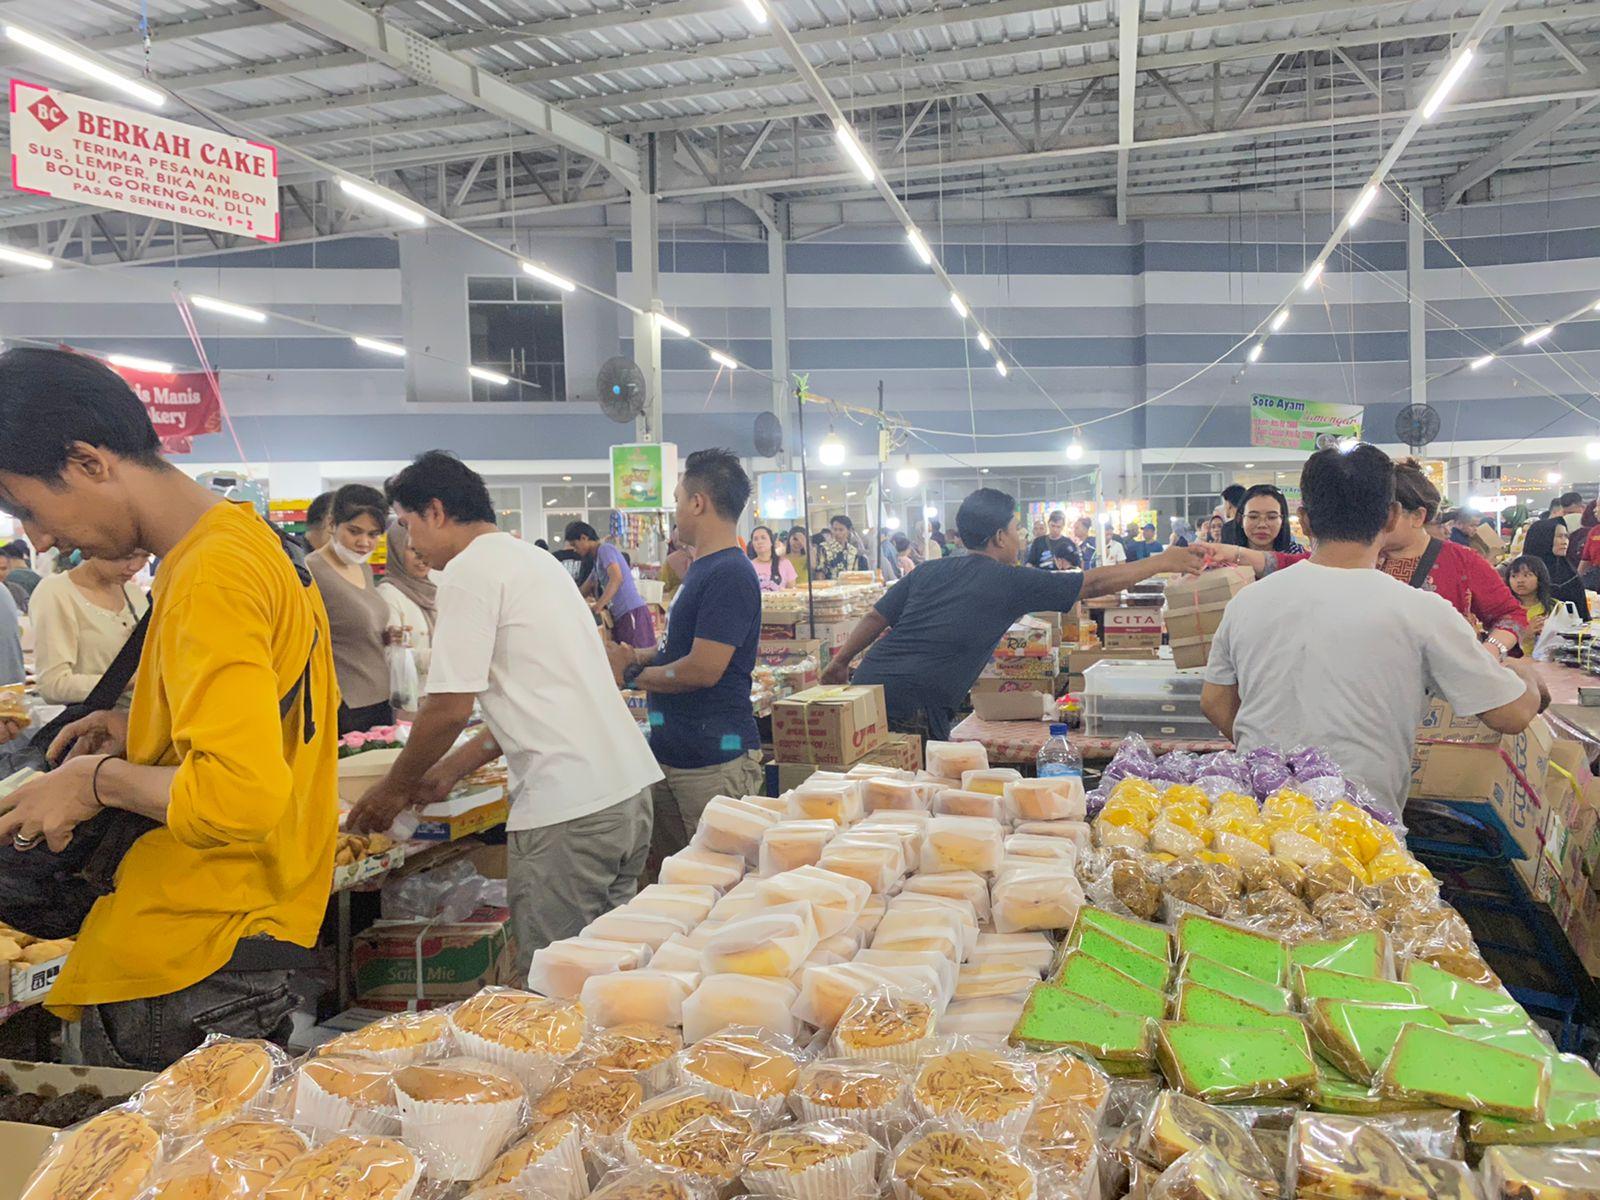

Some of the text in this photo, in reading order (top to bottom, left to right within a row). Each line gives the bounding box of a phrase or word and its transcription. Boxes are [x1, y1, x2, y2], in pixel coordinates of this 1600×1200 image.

[37, 103, 60, 123] BC
[78, 111, 265, 177] BERKAH CAKE
[73, 139, 230, 185] TERIMA PESANAN
[73, 183, 123, 200] PASAR
[129, 194, 175, 211] SENEN
[156, 173, 196, 190] BIKA
[204, 184, 266, 206] AMBON
[225, 201, 252, 216] DLL
[131, 383, 201, 405] is Manis
[1252, 395, 1304, 411] Soto Ayam
[147, 406, 187, 429] kery
[1113, 615, 1155, 624] CITA
[427, 966, 455, 981] Mie
